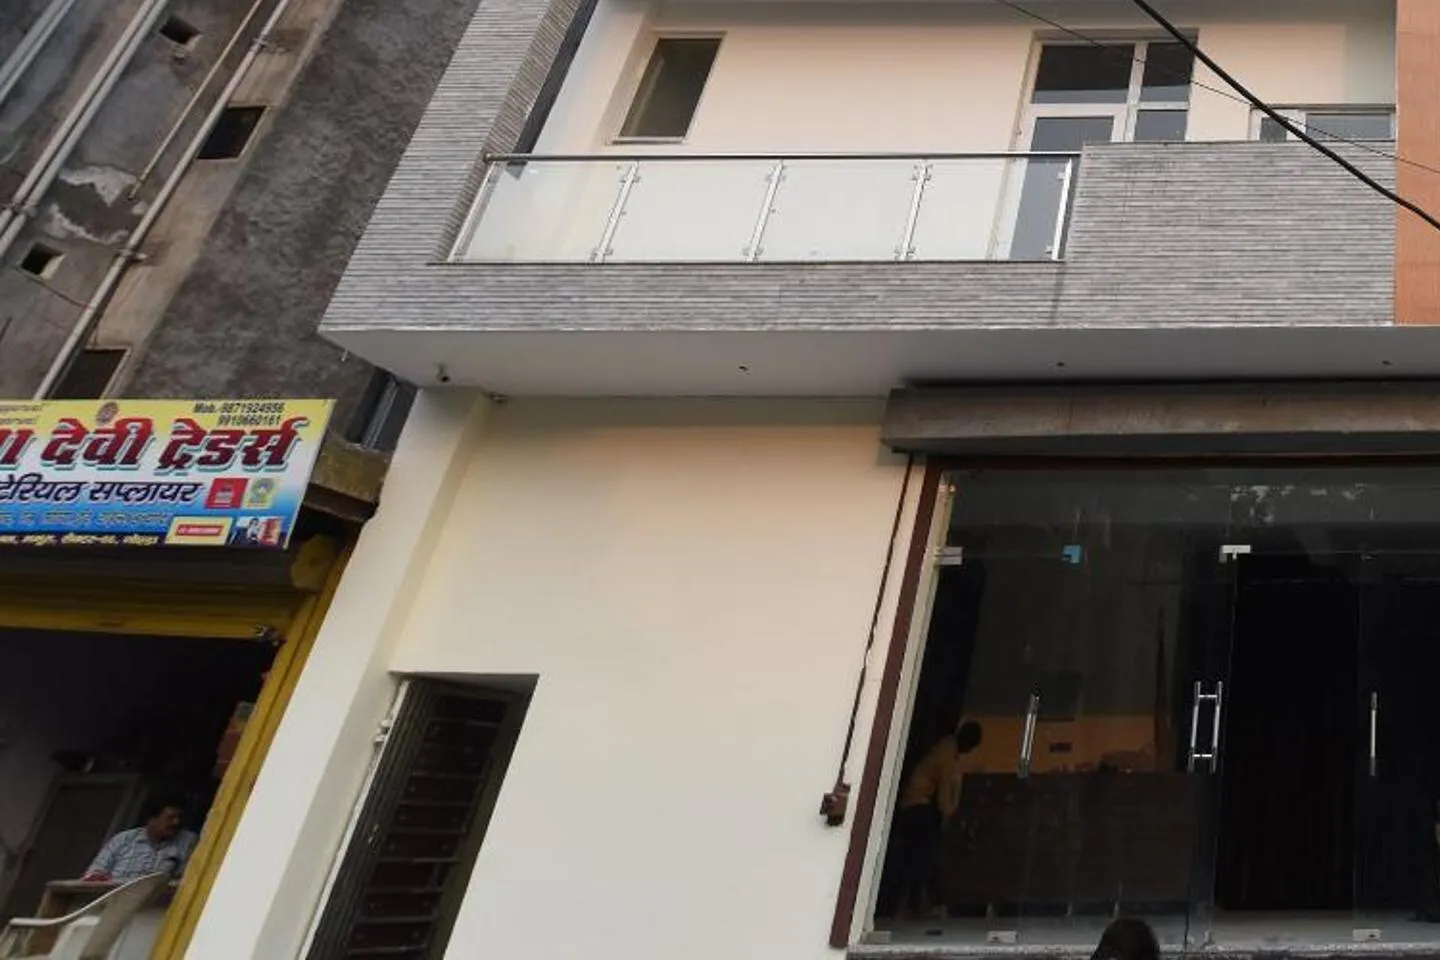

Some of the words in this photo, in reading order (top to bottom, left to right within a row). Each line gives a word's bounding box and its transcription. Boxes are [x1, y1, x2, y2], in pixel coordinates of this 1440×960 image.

[40, 417, 156, 470] देवी
[155, 416, 308, 474] ट्रेडर्स
[88, 480, 204, 502] सप्लायर
